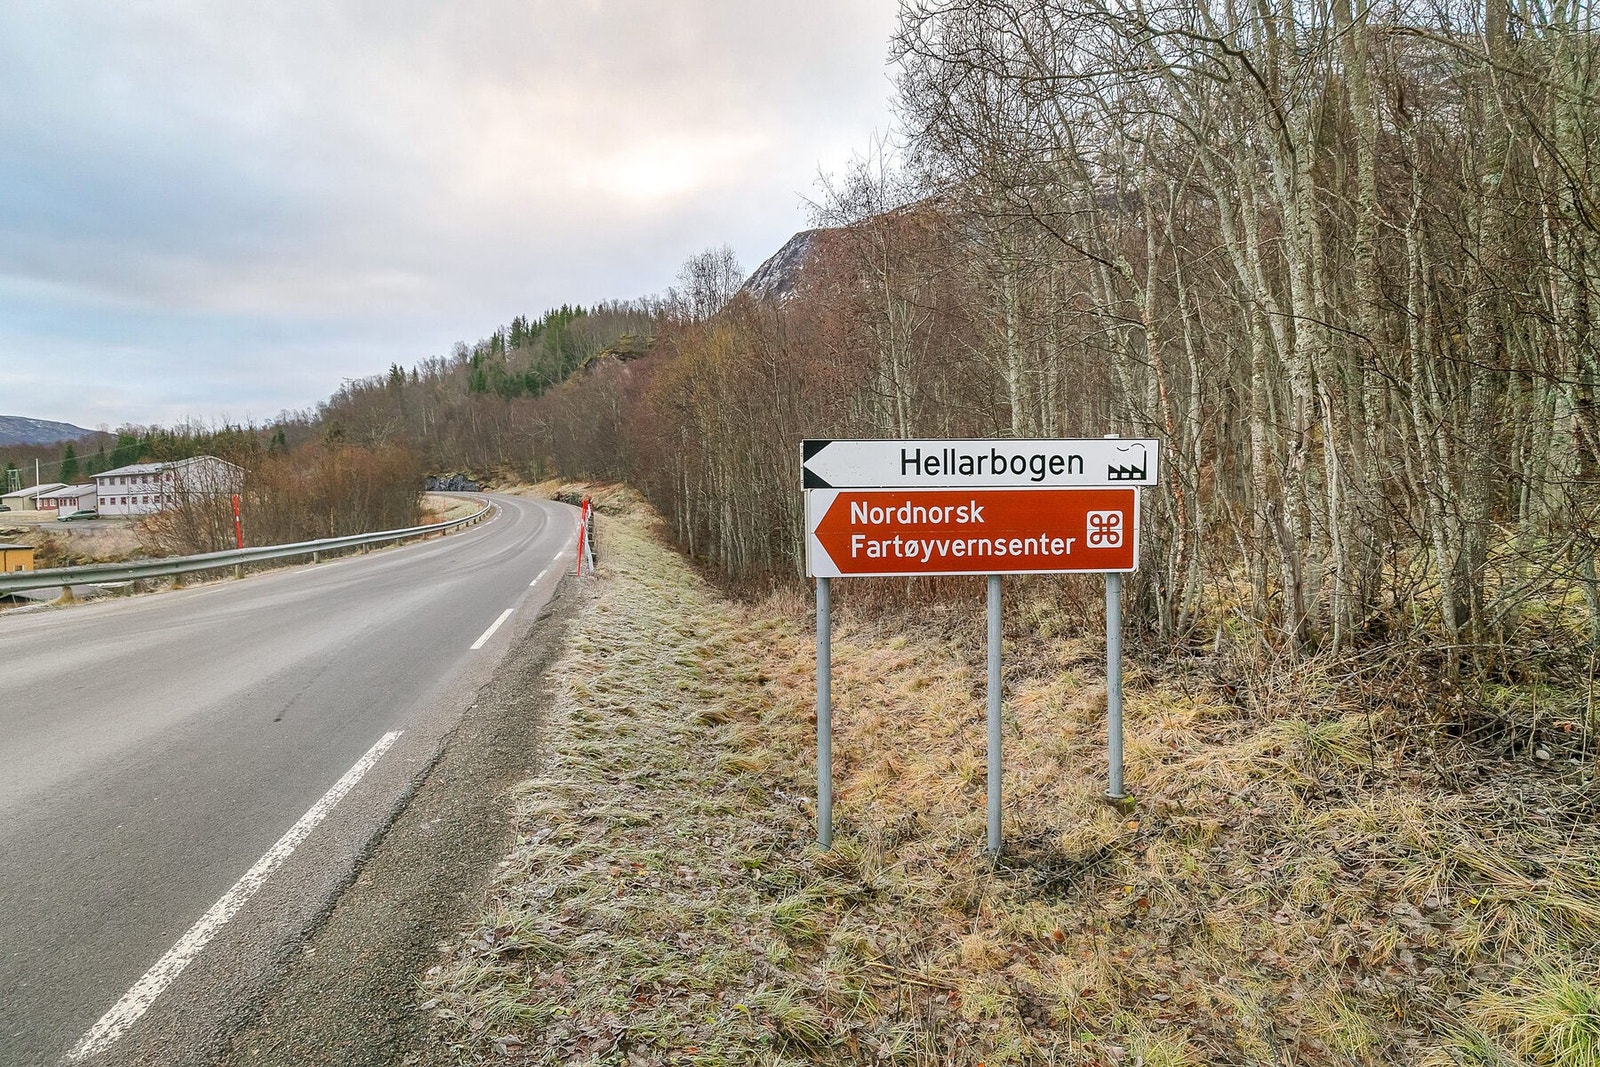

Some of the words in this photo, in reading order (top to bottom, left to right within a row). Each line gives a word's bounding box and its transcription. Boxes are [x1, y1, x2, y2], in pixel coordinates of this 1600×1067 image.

[900, 448, 1084, 481] Hellarbogen
[850, 500, 985, 525] Nordnorsk
[851, 532, 1076, 563] Fartøyvernsenter
